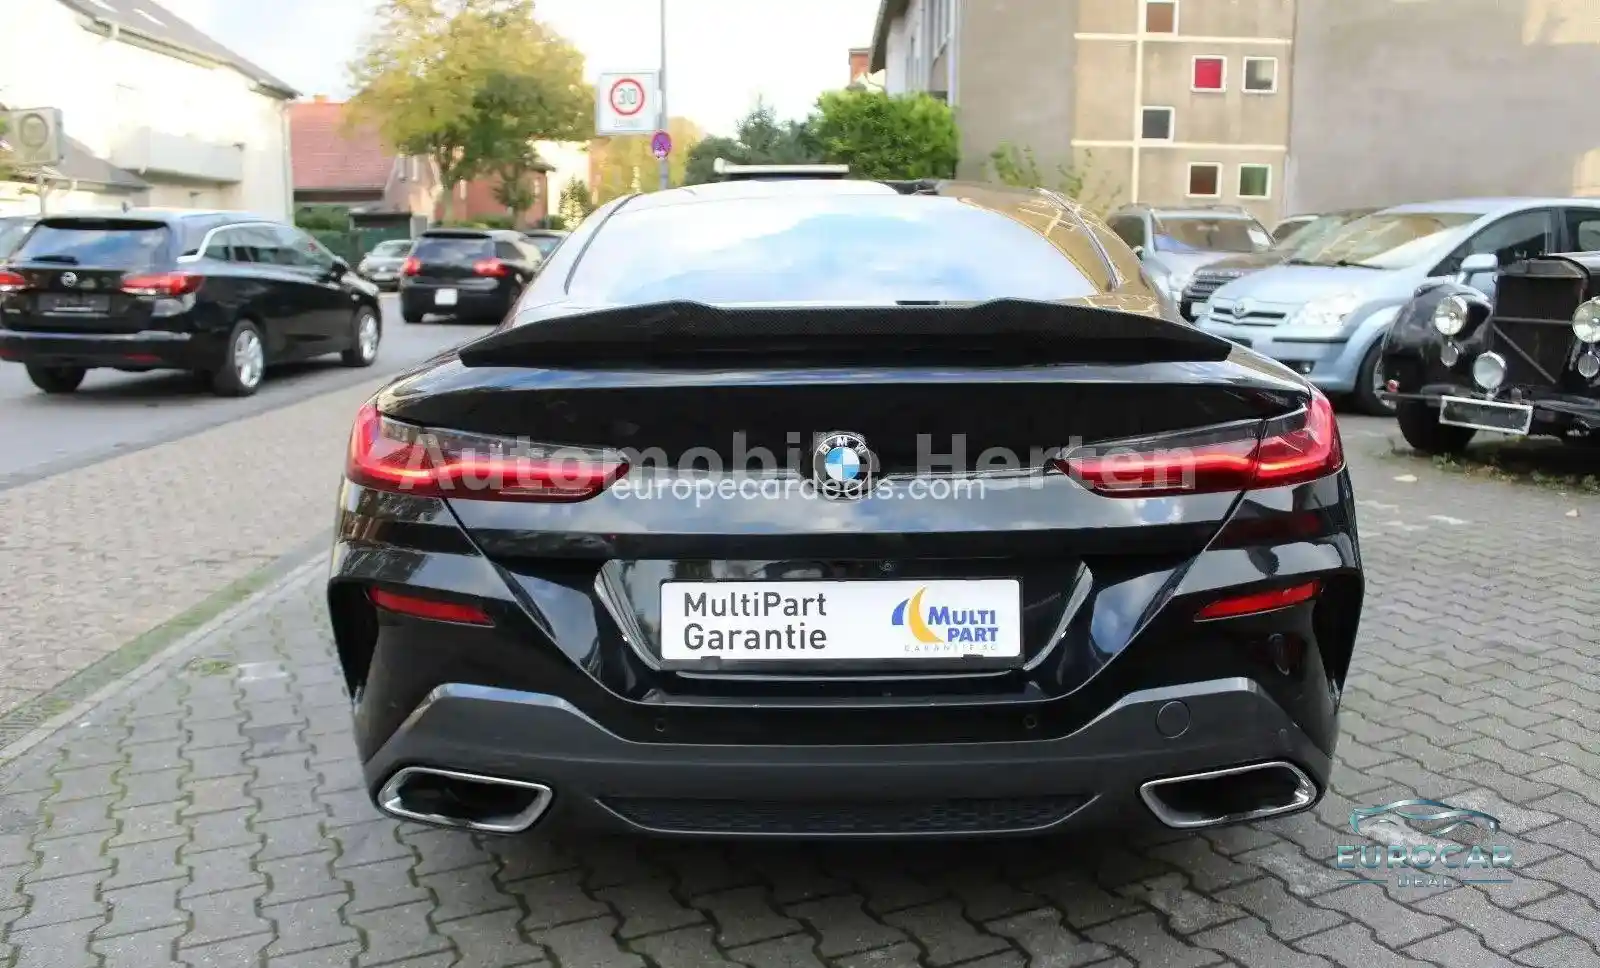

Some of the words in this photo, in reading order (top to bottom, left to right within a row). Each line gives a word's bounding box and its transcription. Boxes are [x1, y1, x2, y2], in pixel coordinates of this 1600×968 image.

[615, 88, 637, 105] 30
[819, 436, 868, 456] BMW
[683, 592, 827, 617] MultiPart
[683, 622, 827, 650] Garantie
[947, 627, 999, 642] PART
